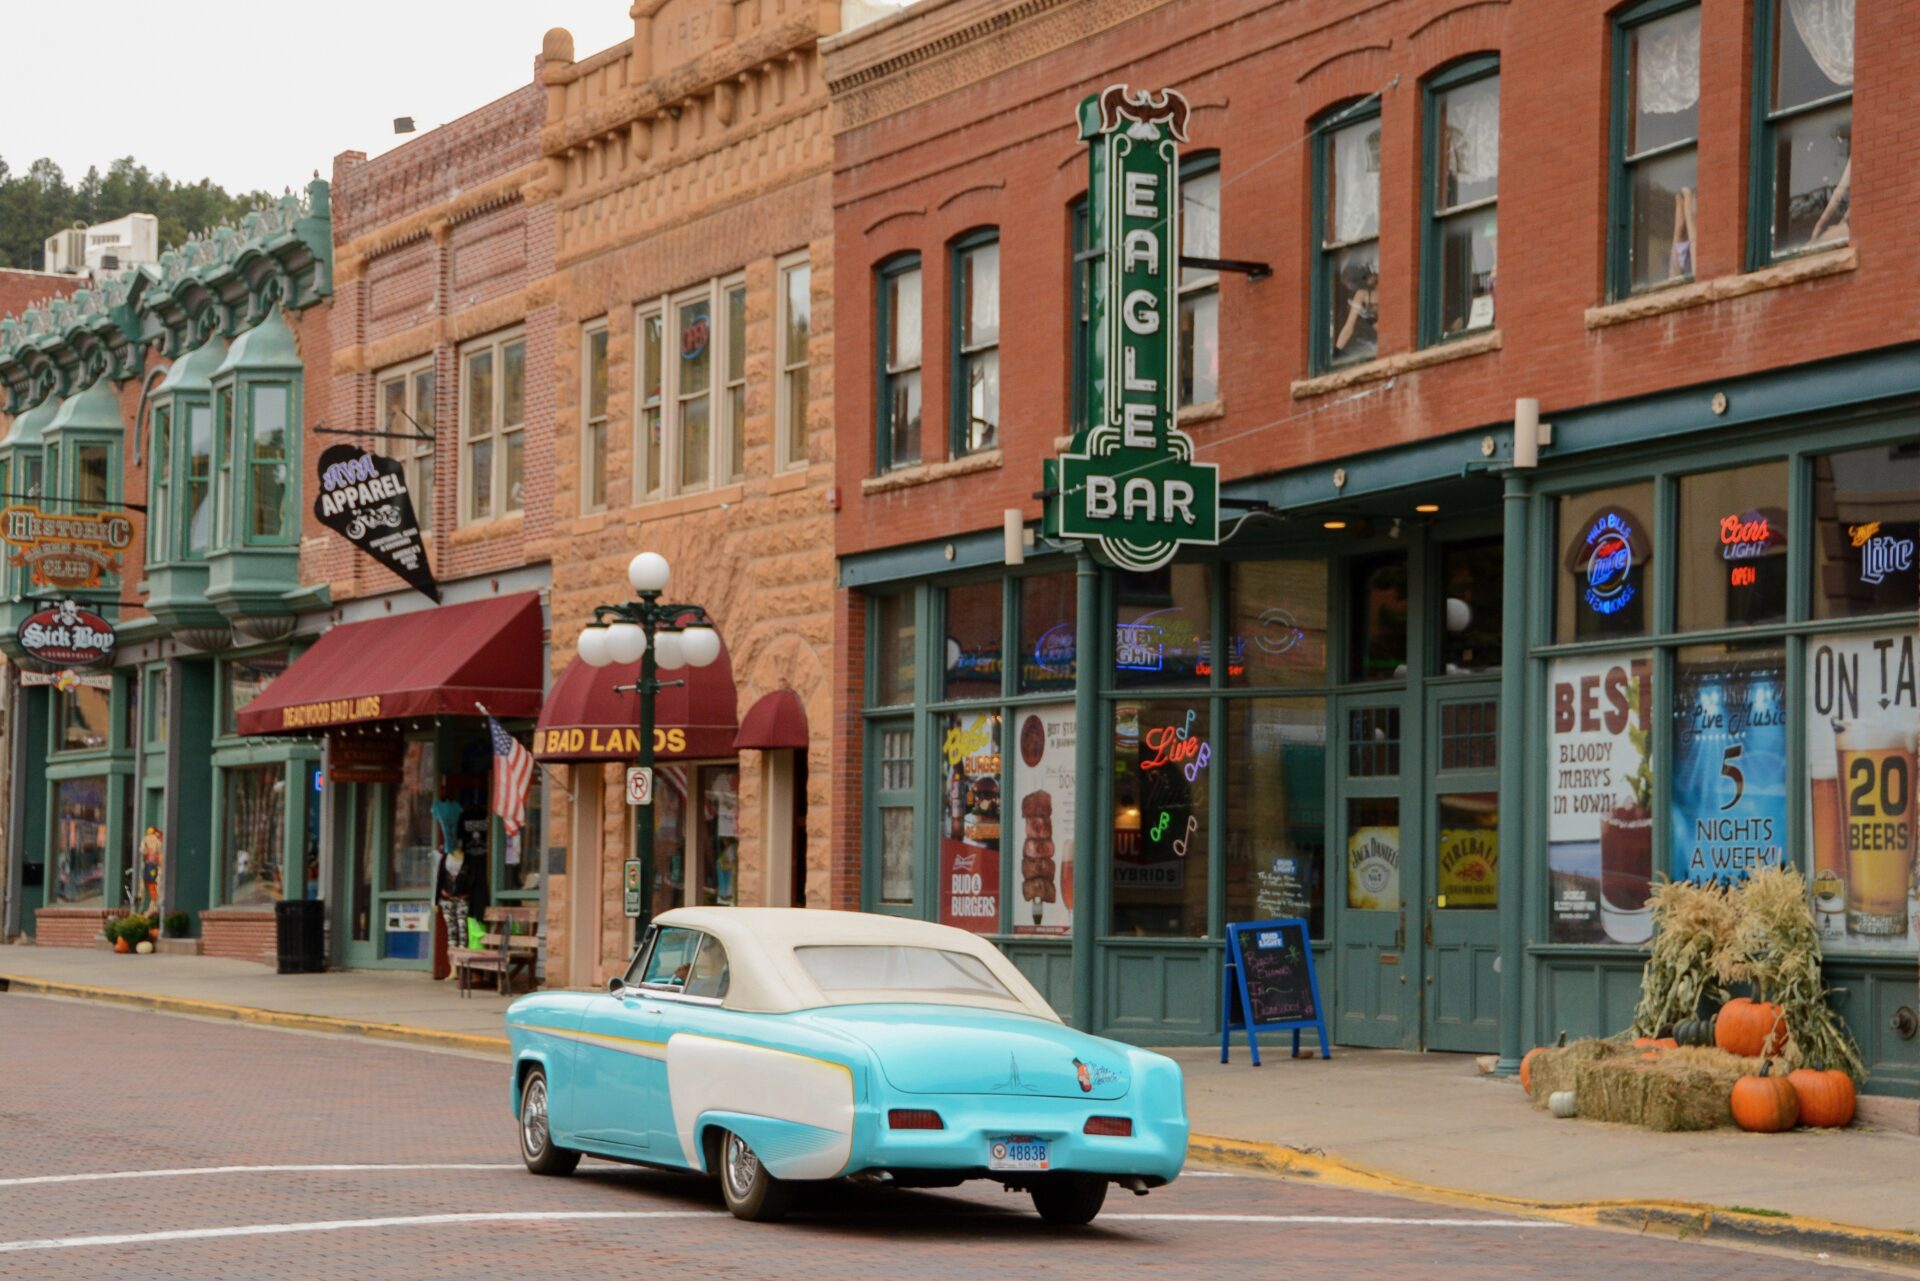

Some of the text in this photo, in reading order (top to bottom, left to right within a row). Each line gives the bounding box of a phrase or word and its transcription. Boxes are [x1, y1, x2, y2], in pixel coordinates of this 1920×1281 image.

[1122, 171, 1161, 449] EAGLE
[322, 473, 406, 517] APPAREL
[1086, 474, 1196, 525] BAR
[8, 511, 130, 548] HISTORIC
[1720, 514, 1769, 544] Coors
[1724, 541, 1767, 559] LIGHT
[1860, 536, 1914, 584] Lite
[1731, 567, 1755, 587] OPEN
[21, 622, 115, 653] Sick Boy
[1555, 658, 1652, 735] BEST
[1814, 645, 1859, 721] ON
[1685, 704, 1725, 735] Live
[546, 729, 585, 754] BAD
[1140, 726, 1198, 770] Live
[1559, 742, 1613, 763] BLOODY
[1720, 744, 1744, 811] 5
[1849, 756, 1909, 817] 20
[1697, 818, 1773, 842] NIGHTS
[1849, 823, 1909, 851] BEERS
[1691, 848, 1706, 869] A
[952, 873, 971, 895] BUD
[951, 895, 996, 917] BURGERS
[1009, 1145, 1046, 1161] 4883B
